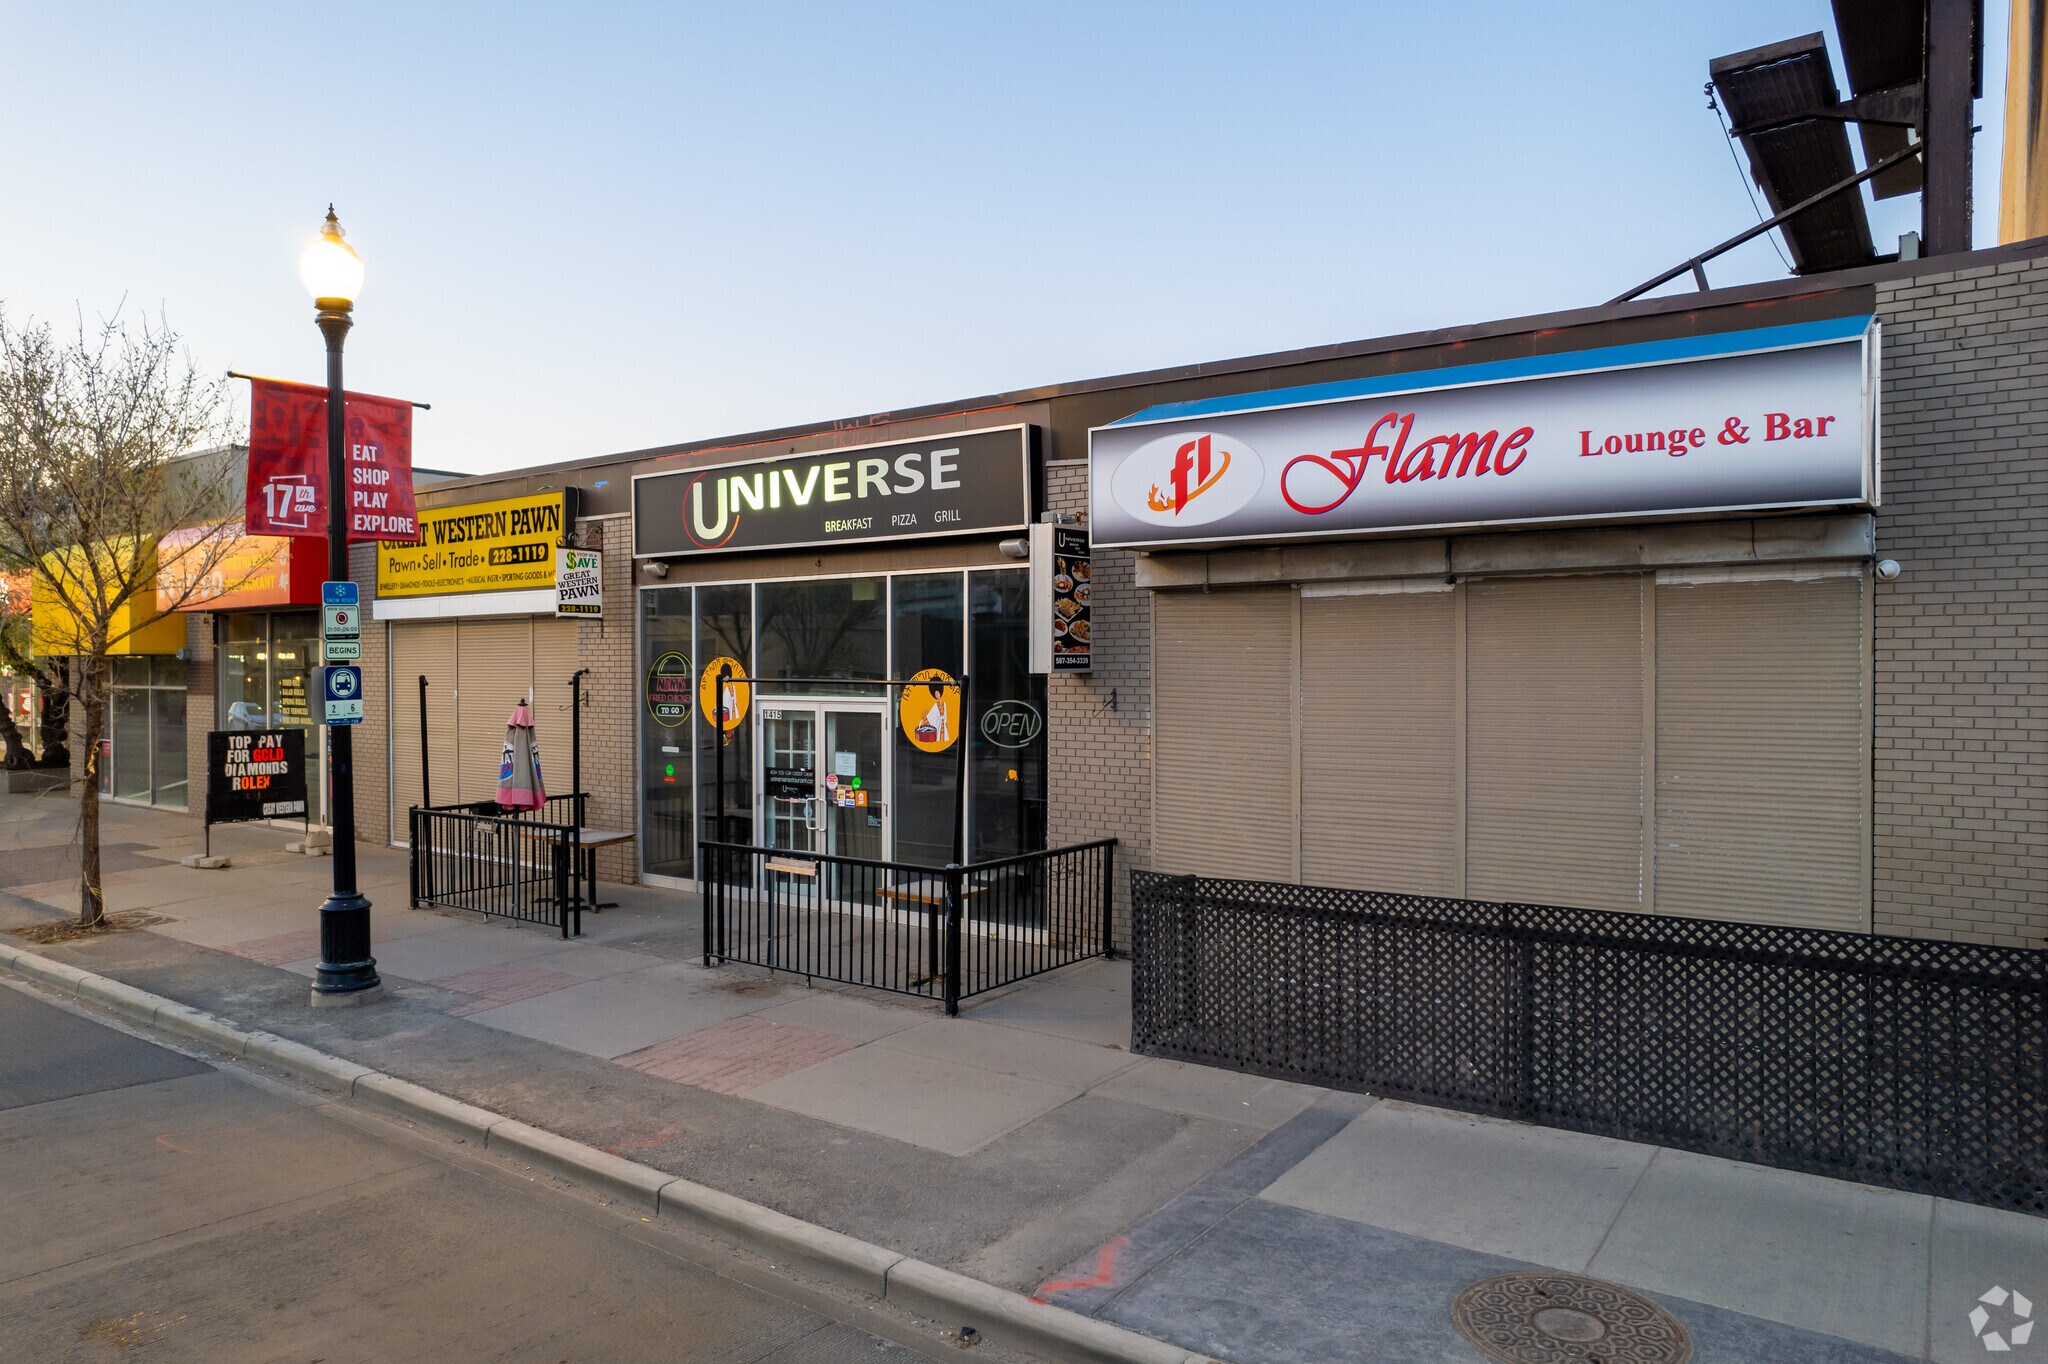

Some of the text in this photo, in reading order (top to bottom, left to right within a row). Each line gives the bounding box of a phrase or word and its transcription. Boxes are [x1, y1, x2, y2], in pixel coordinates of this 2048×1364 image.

[1578, 427, 1706, 457] Lounge
[1717, 416, 1750, 445] &
[1763, 412, 1835, 442] Bar
[352, 444, 377, 462] EAT
[353, 467, 389, 486] SHOP
[353, 491, 389, 509] PLAY
[693, 447, 961, 540] UNIVERSE
[294, 503, 317, 513] ave
[354, 514, 415, 534] EXPLORE
[432, 504, 561, 545] WESTERN PAWN
[825, 509, 961, 533] BREAKFAST PIZZA GRILL
[389, 545, 546, 574] Pawn Sell Trade 228-1119
[558, 577, 598, 589] WESTERN
[563, 570, 591, 581] GREAT
[559, 585, 600, 601] PAWN
[561, 605, 599, 613] 228-1119
[331, 704, 336, 713] 2
[350, 703, 355, 712] 6
[984, 712, 1036, 737] OPEN
[228, 734, 283, 749] TOP PAY
[226, 749, 250, 763] FOR
[232, 775, 271, 791] ROLEX
